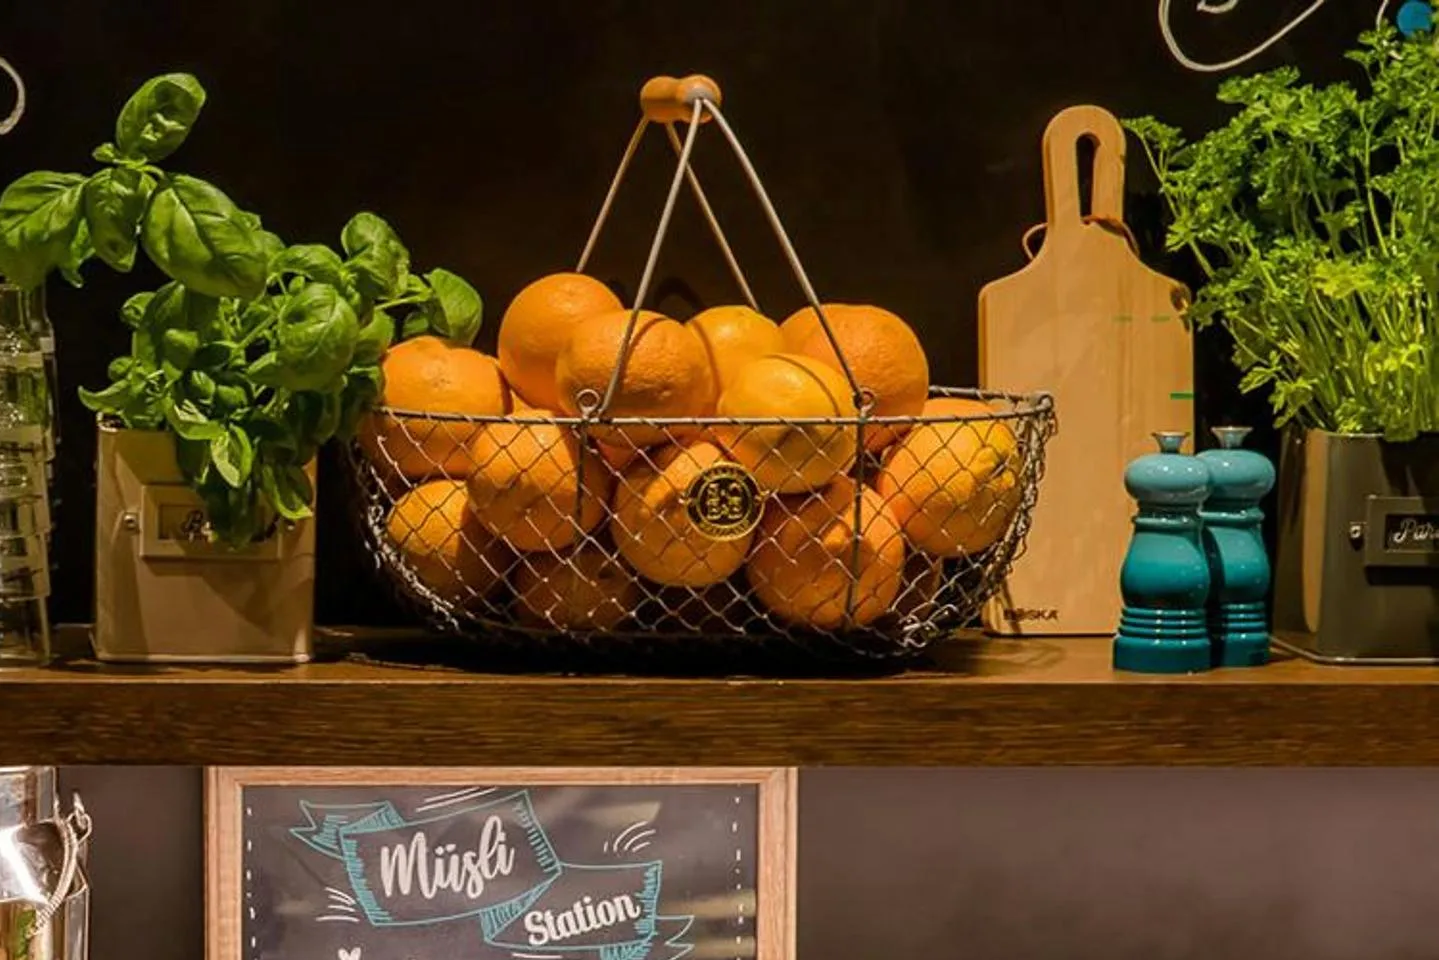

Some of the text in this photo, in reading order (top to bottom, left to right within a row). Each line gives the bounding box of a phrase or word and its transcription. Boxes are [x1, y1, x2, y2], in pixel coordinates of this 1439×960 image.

[1393, 517, 1439, 543] Par
[380, 815, 515, 899] Müsli
[524, 894, 641, 946] Station
